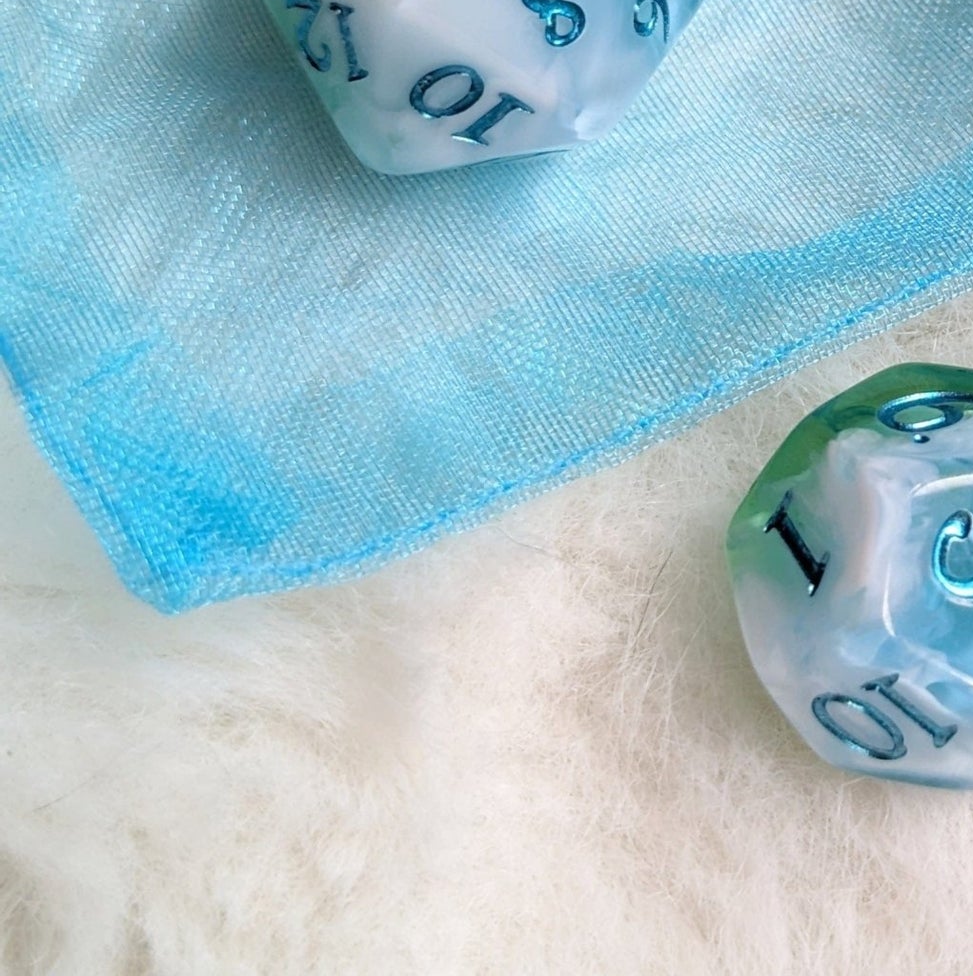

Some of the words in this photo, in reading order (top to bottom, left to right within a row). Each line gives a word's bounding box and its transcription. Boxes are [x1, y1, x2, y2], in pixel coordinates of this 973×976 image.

[409, 64, 535, 146] 10
[763, 488, 831, 598] 1
[811, 672, 958, 761] 10
